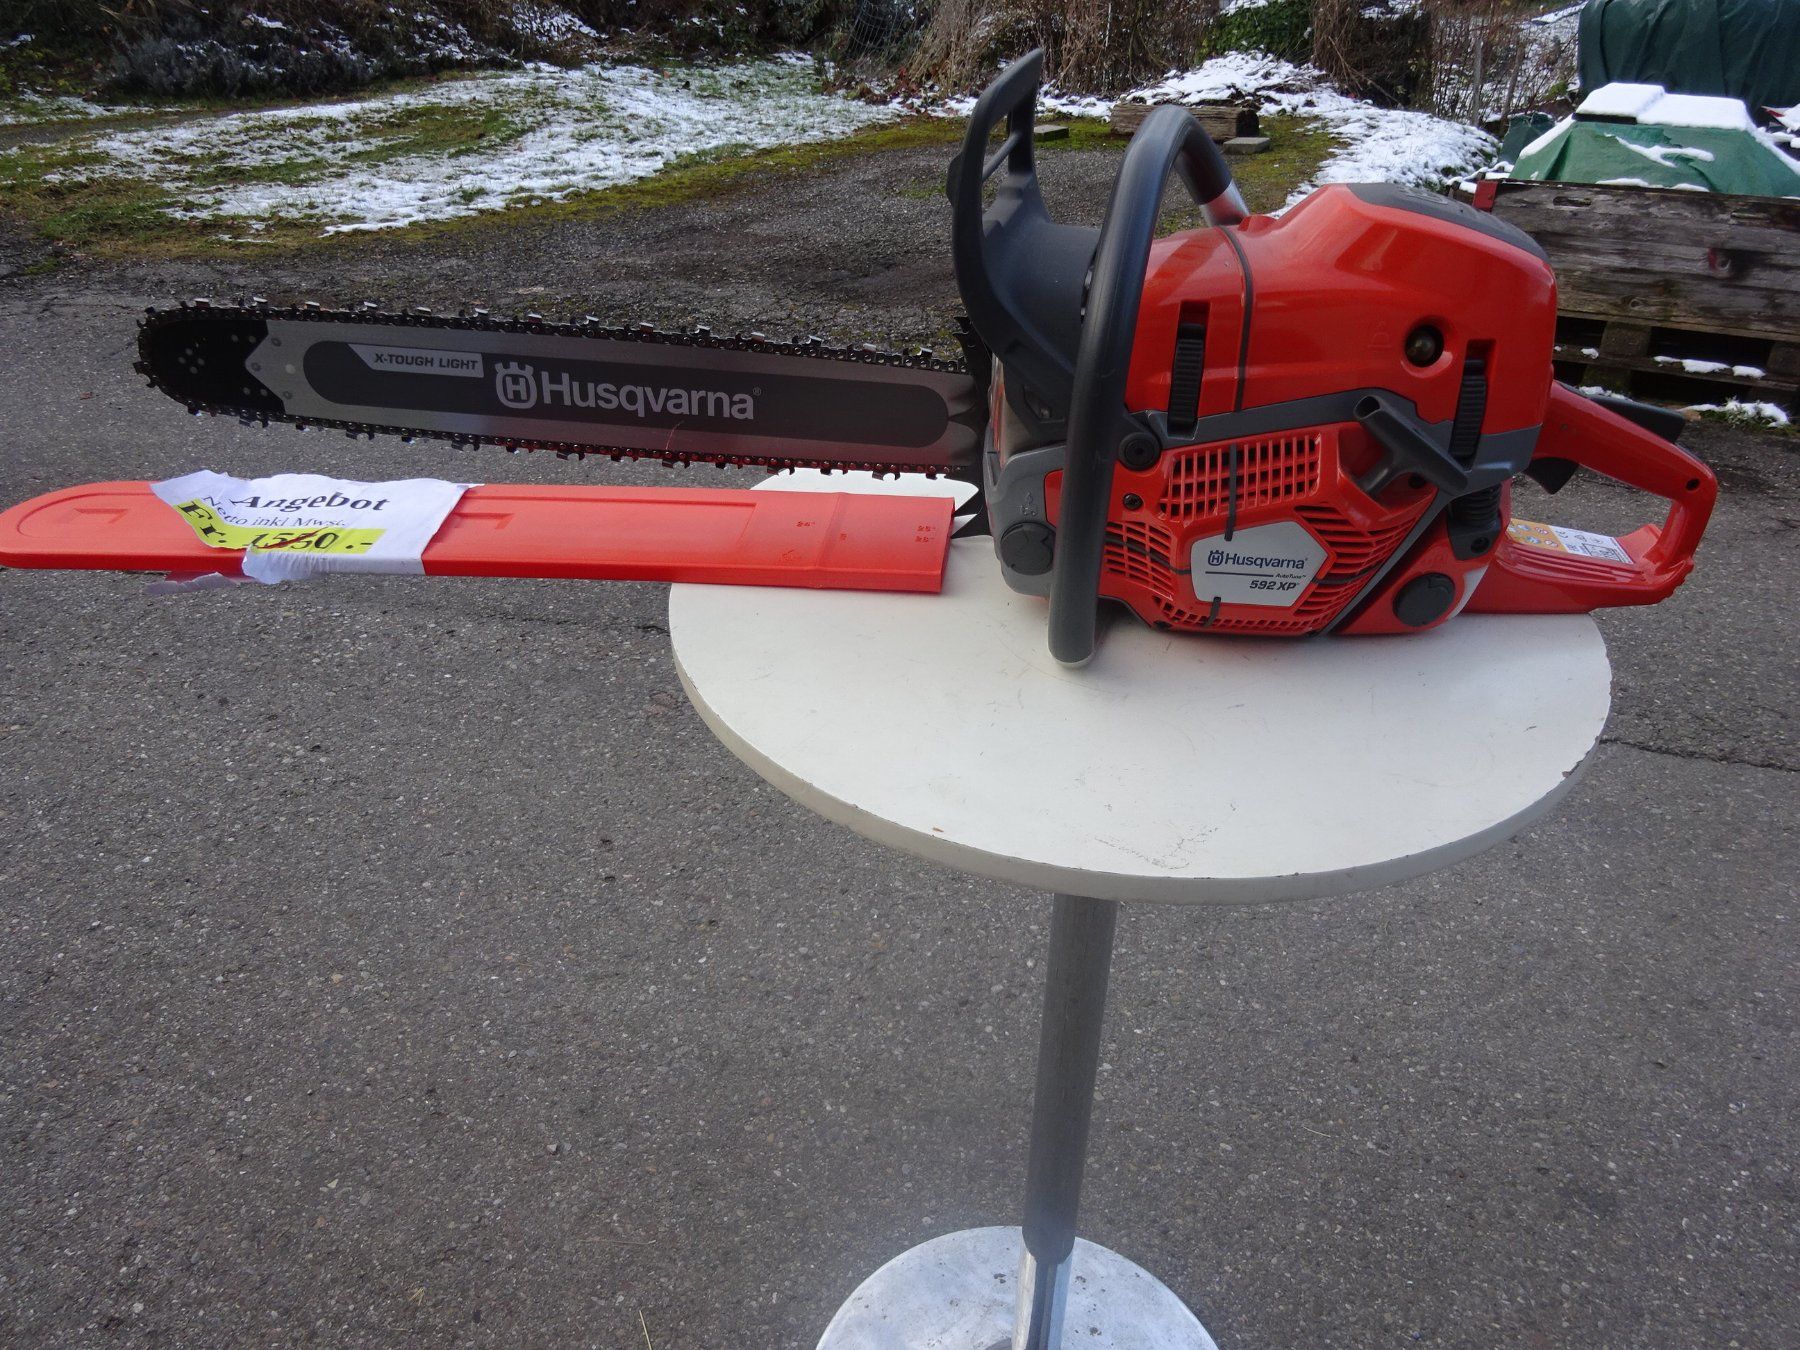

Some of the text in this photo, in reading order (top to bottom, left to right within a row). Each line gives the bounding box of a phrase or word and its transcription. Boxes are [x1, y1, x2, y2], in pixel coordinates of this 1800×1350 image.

[374, 353, 478, 370] X-TOUGH LIGHT
[541, 371, 755, 420] Husqvarna
[203, 496, 247, 524] Netto
[229, 492, 390, 512] Angebot
[177, 500, 226, 543] Fr.
[1225, 553, 1305, 569] Husqvarna
[1249, 580, 1297, 591] 592 XP
